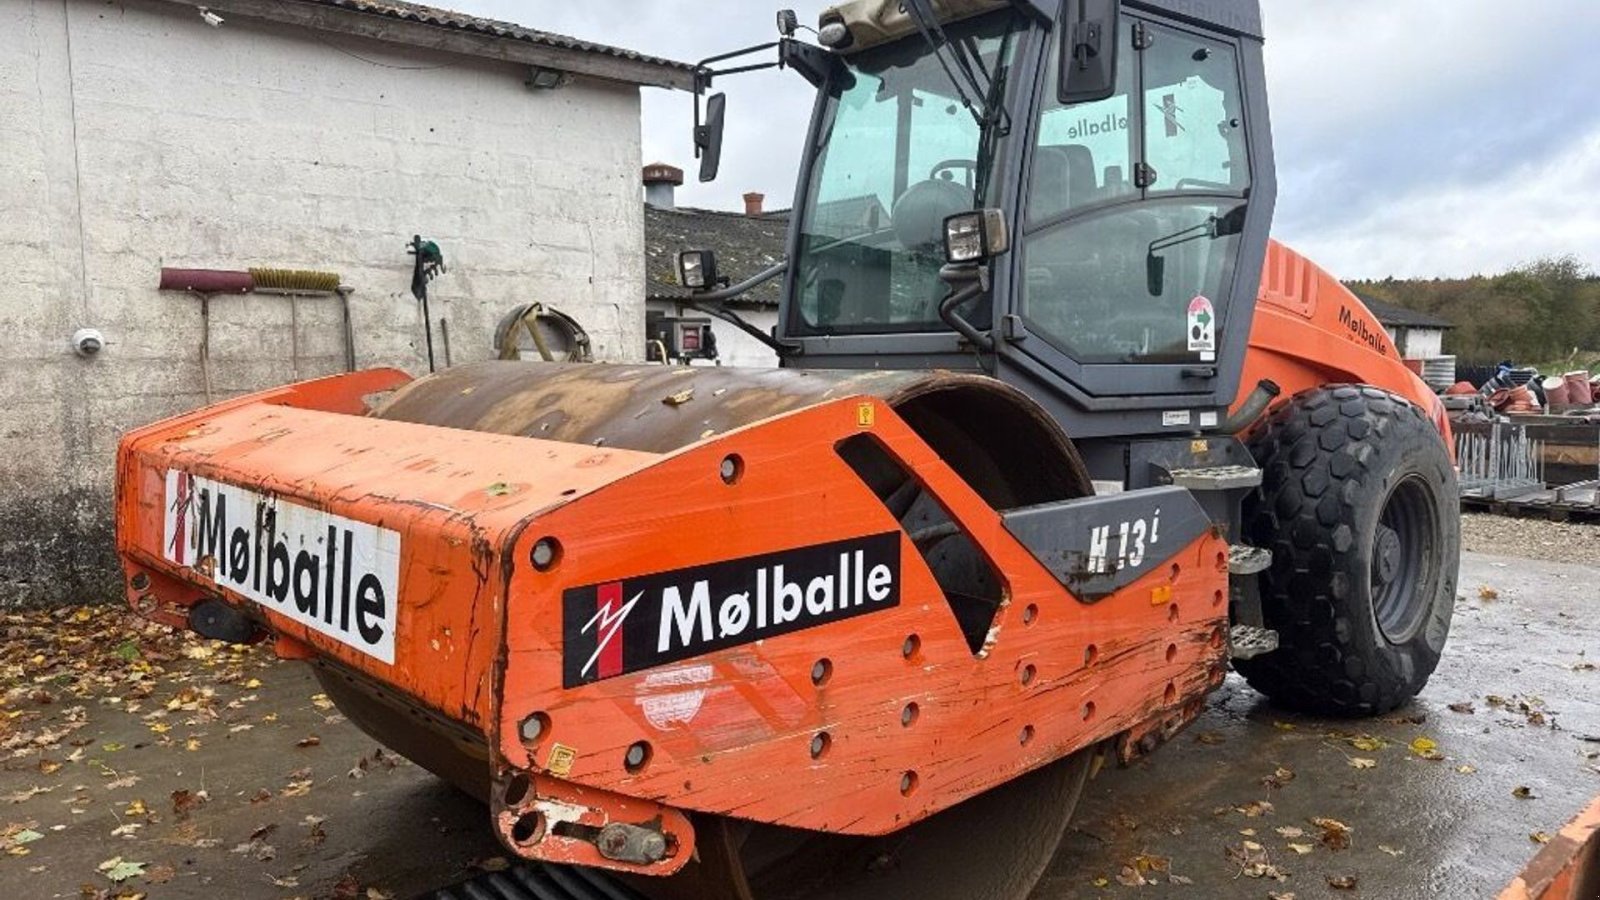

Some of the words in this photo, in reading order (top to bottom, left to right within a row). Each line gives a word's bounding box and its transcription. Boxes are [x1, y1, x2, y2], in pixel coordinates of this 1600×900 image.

[197, 487, 386, 645] Mølballe
[657, 549, 892, 653] Mølballe
[1087, 525, 1109, 573] H
